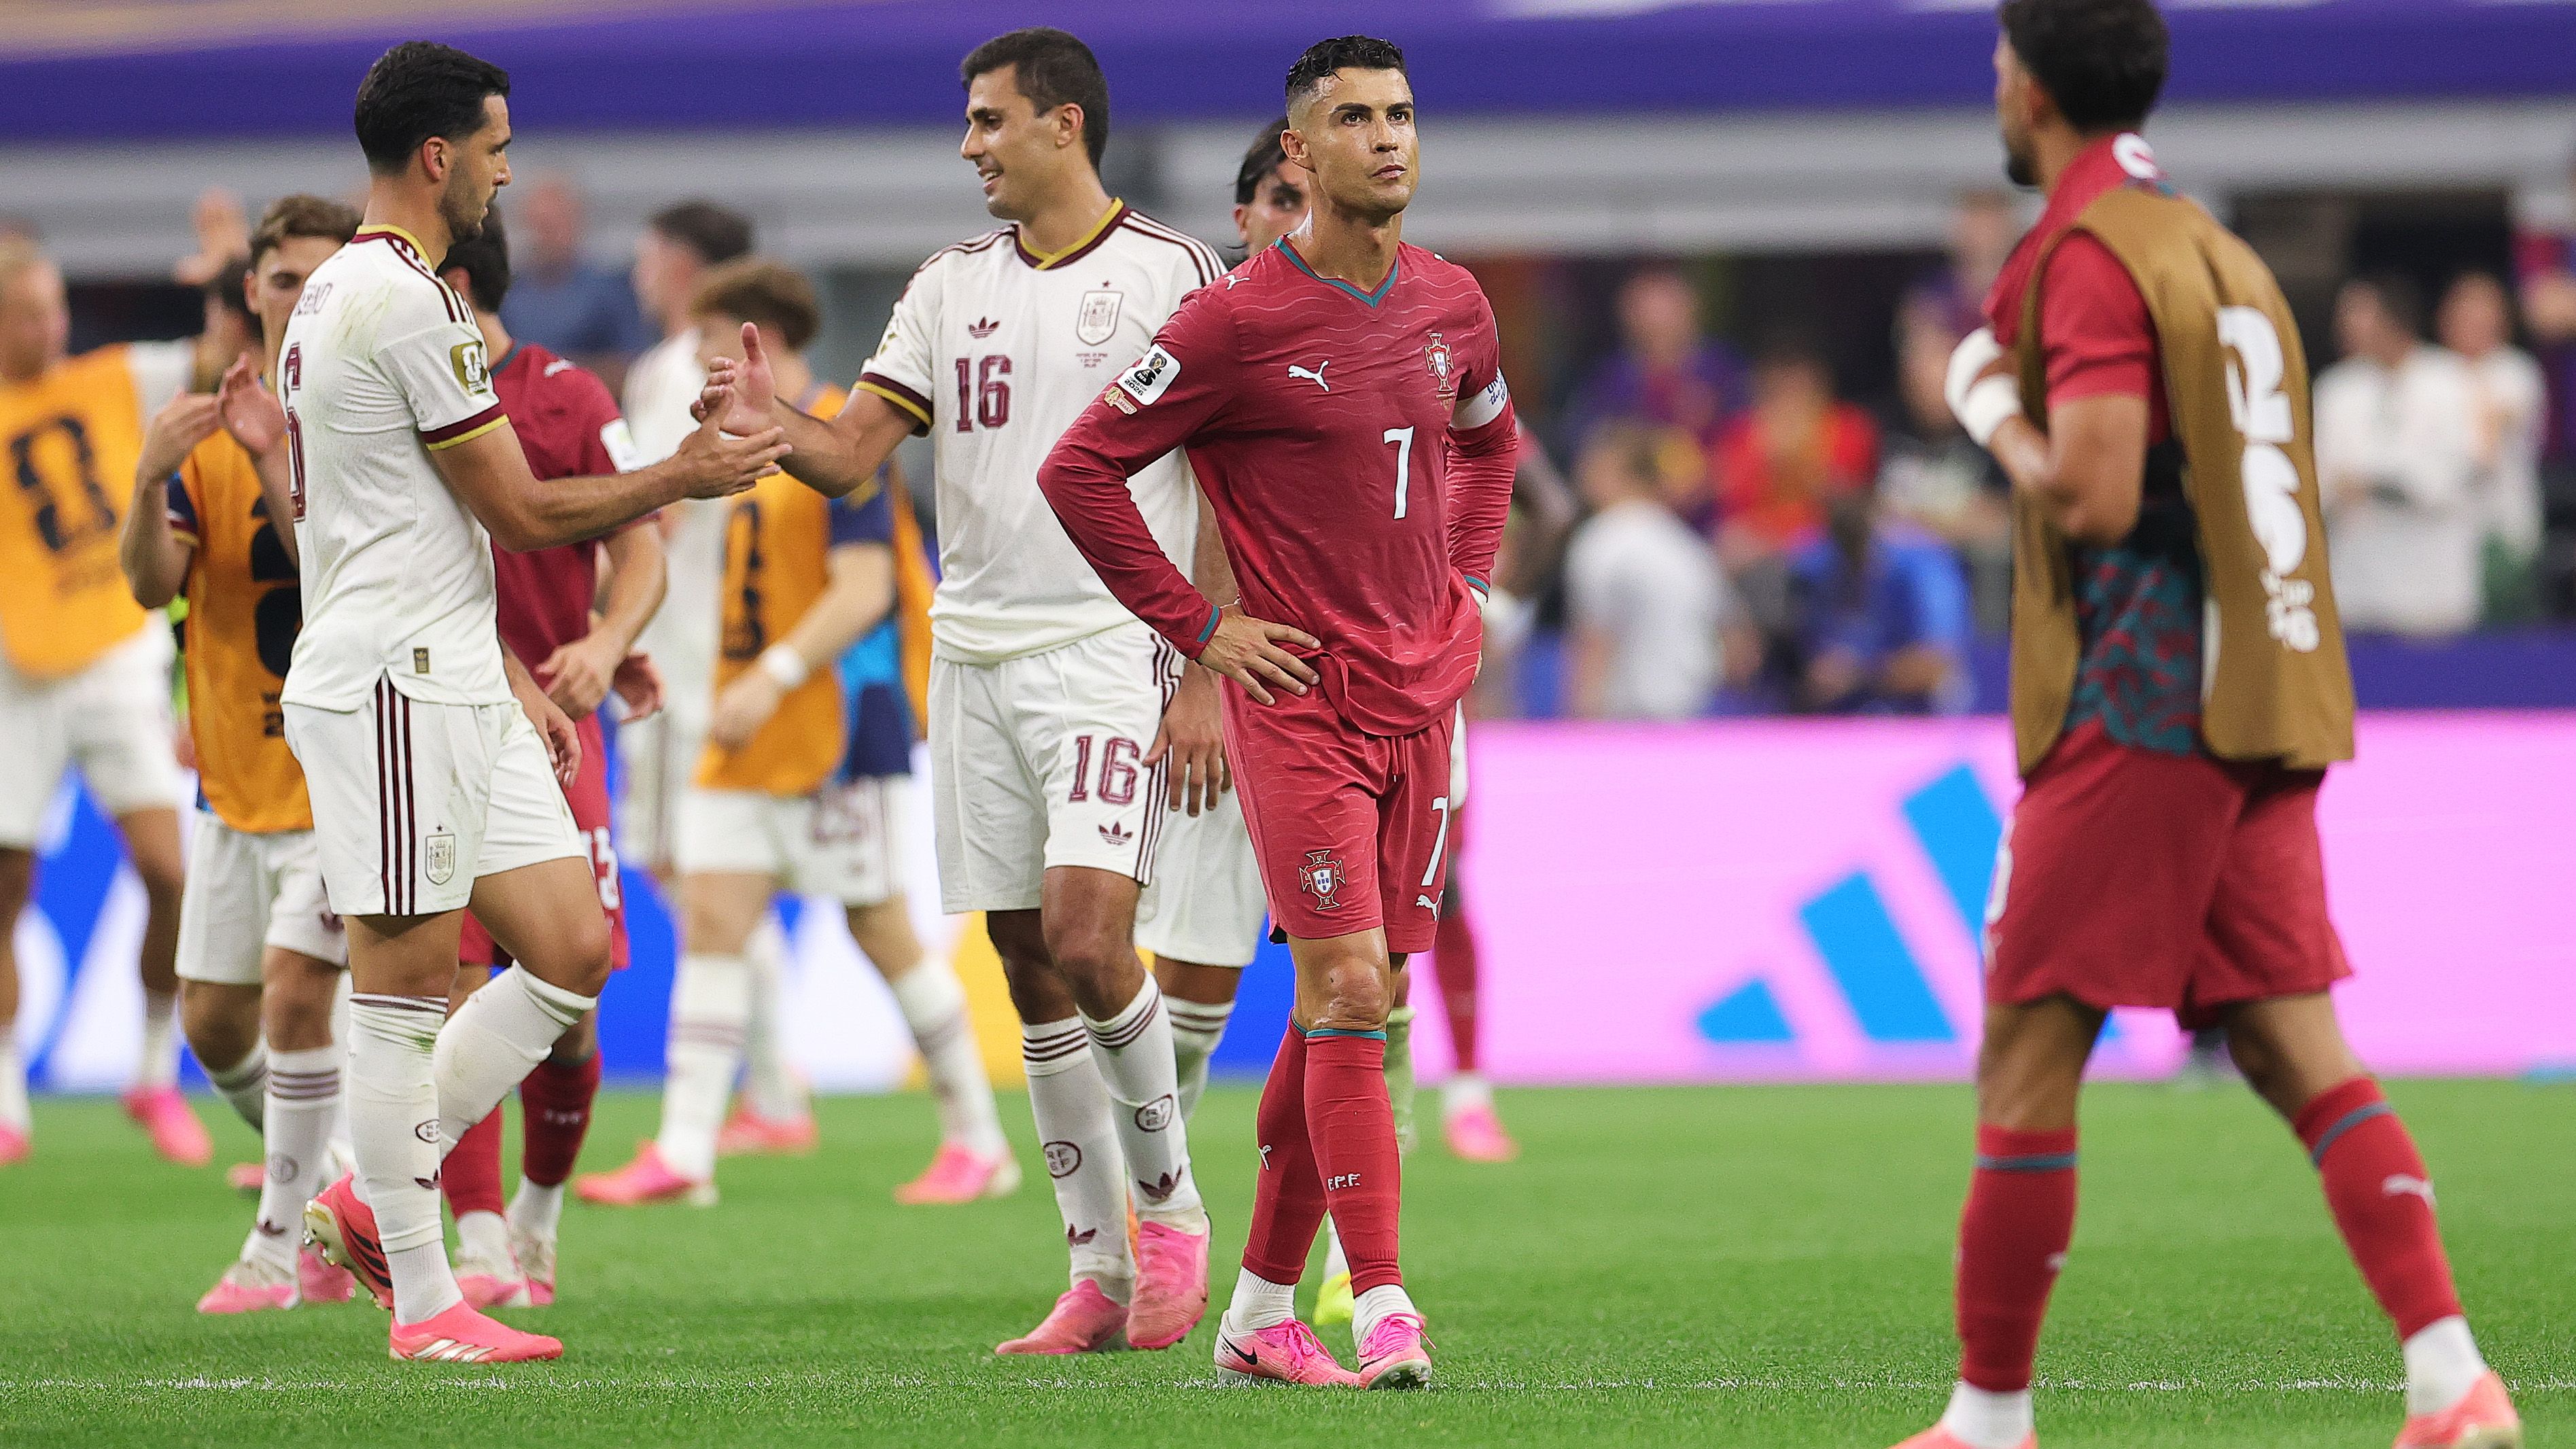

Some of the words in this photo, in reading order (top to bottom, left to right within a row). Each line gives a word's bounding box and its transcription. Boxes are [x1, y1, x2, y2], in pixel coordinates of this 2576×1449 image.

[954, 354, 1013, 434] 16
[1124, 378, 1145, 396] 2026
[1136, 372, 1148, 383] FIFA
[1382, 425, 1415, 520] 7
[1068, 734, 1141, 807] 16
[1420, 795, 1450, 886] 7
